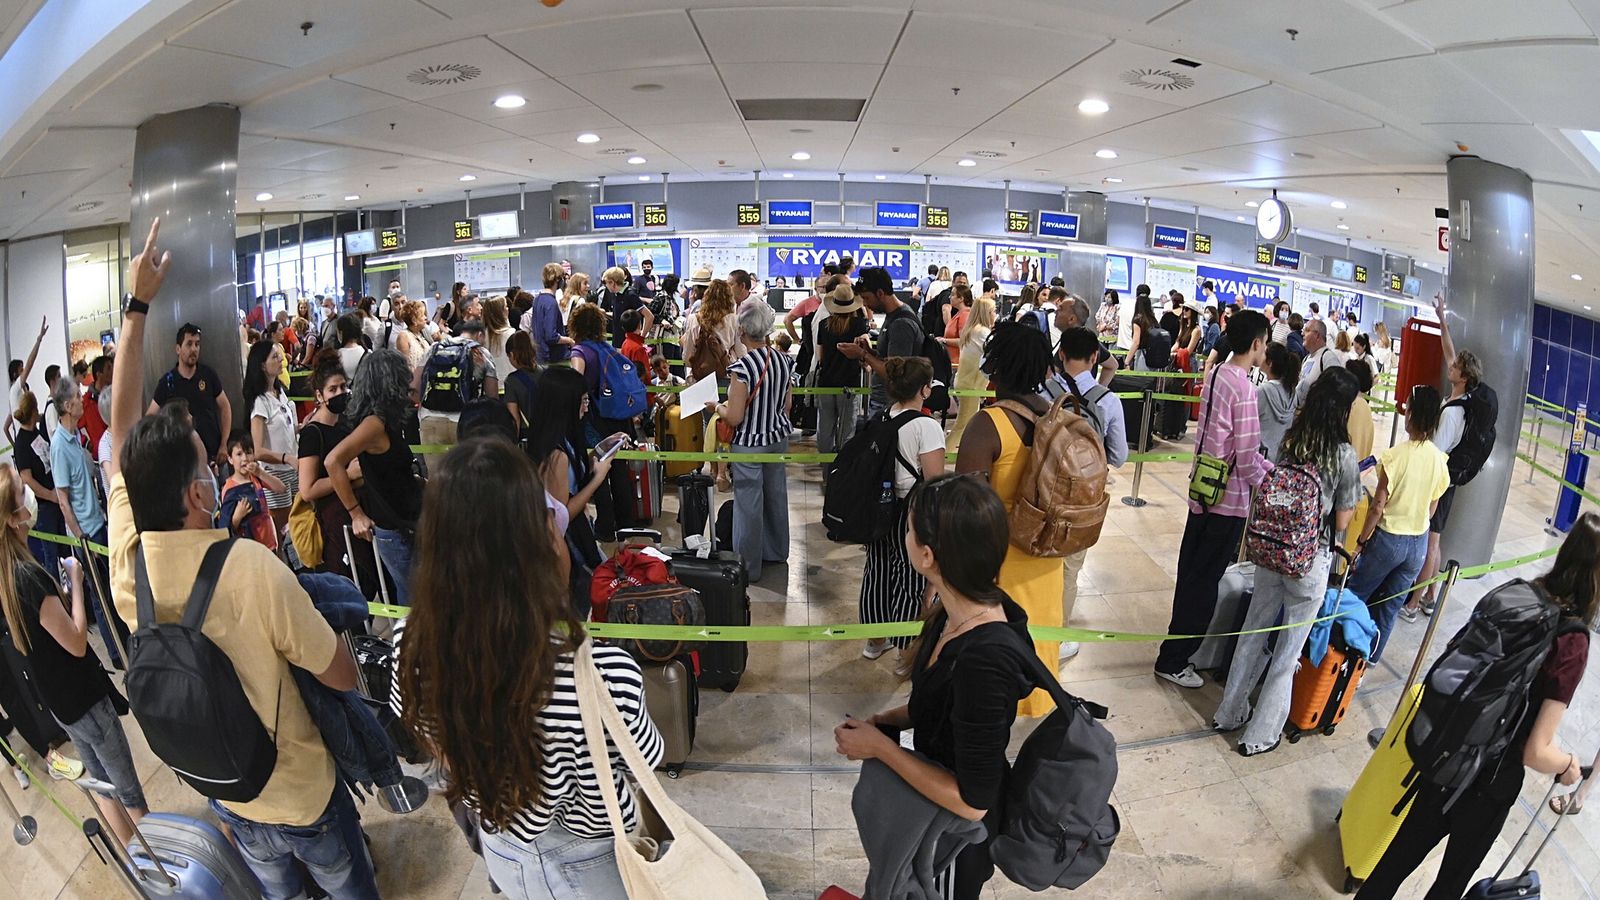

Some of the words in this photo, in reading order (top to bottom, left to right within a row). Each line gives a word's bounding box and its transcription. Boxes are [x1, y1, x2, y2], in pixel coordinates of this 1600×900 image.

[645, 213, 666, 224] 360
[739, 213, 760, 223] 359
[883, 211, 917, 219] RYANAIR
[927, 215, 948, 226] 358
[1009, 220, 1028, 231] 357
[1046, 221, 1076, 230] RYANAIR
[455, 228, 471, 238] 361
[382, 236, 397, 247] 362
[1159, 234, 1185, 243] RYANAIR
[1195, 241, 1210, 252] 356
[792, 249, 903, 267] RYANAIR
[1257, 253, 1271, 263] 355
[1356, 272, 1366, 282] 354
